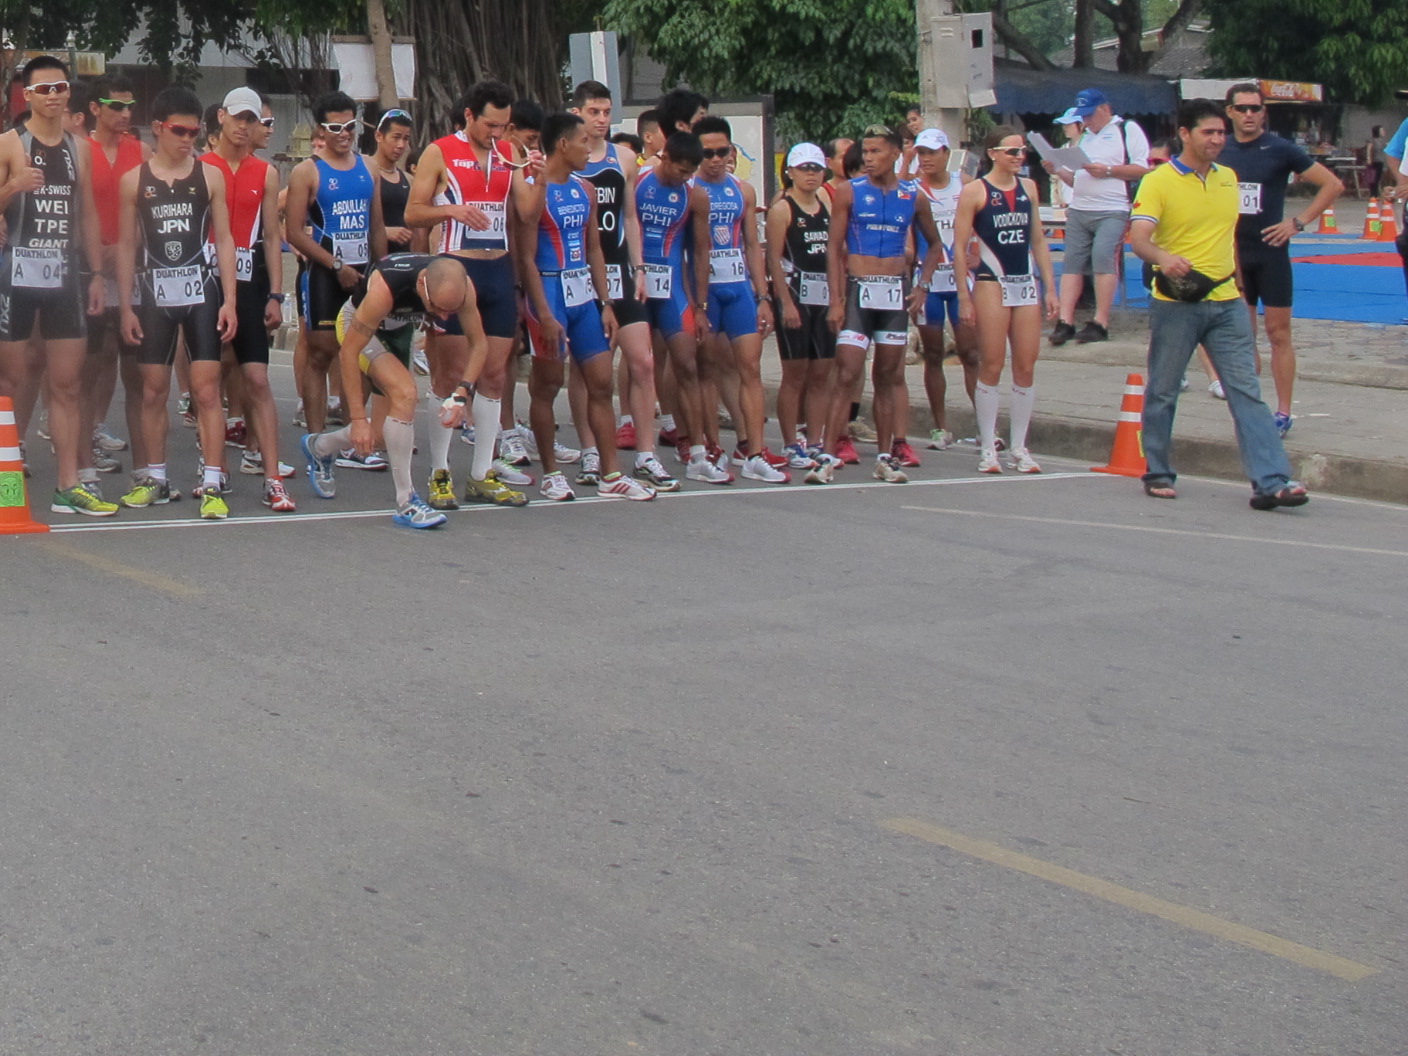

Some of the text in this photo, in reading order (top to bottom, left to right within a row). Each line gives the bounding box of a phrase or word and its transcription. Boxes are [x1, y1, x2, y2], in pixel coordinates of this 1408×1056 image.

[40, 185, 72, 195] K-SWISS
[35, 198, 69, 214] WEI
[1243, 195, 1259, 208] 01
[151, 203, 193, 219] KURIHARA
[640, 203, 677, 215] JAVIER
[339, 215, 366, 229] MAS
[563, 214, 584, 228] PHI
[642, 213, 672, 226] PHI
[708, 212, 735, 223] PHI
[993, 214, 1029, 228] VODICKOVA
[34, 218, 68, 234] TPE
[157, 218, 191, 234] JPN
[28, 237, 69, 248] GIANT
[997, 229, 1025, 244] CZE
[15, 248, 59, 259] DUATHLON
[335, 245, 343, 258] A
[14, 263, 24, 279] A
[43, 264, 61, 279] 04
[236, 257, 252, 273] 09
[731, 261, 745, 275] 16
[156, 266, 199, 279] DUATHLON
[156, 284, 166, 300] A
[184, 280, 204, 298] 02
[566, 285, 574, 299] A
[655, 278, 670, 292] 14
[801, 284, 808, 298] B
[861, 288, 871, 302] A
[887, 288, 901, 303] 17
[1021, 286, 1037, 299] 02
